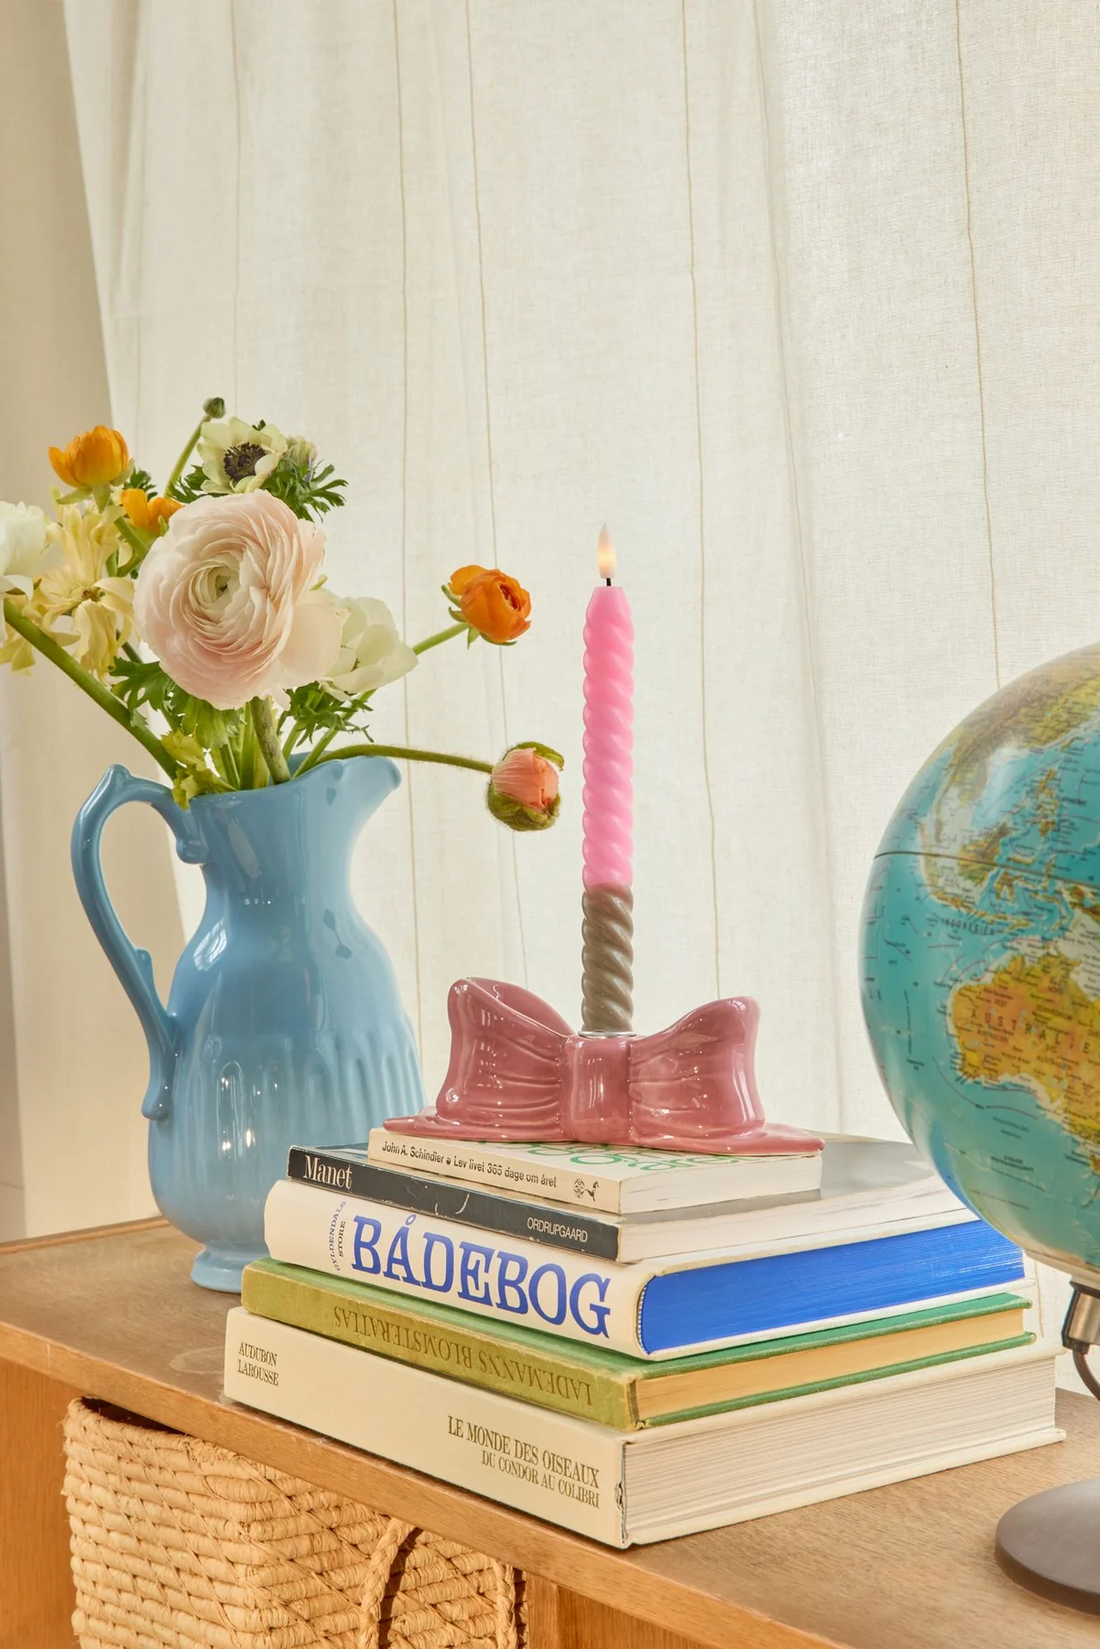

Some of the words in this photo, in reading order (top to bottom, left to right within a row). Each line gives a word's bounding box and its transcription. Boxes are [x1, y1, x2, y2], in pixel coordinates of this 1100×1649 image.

[971, 1008, 1100, 1061] AUSTRALIE
[303, 1155, 353, 1189] Manet
[382, 1141, 400, 1155] John
[400, 1145, 409, 1156] A.
[409, 1146, 445, 1164] Schindler
[453, 1155, 468, 1169] Lev
[468, 1158, 485, 1172] livet
[486, 1163, 503, 1176] 365
[504, 1166, 524, 1181] dage
[525, 1173, 539, 1184] om
[540, 1173, 558, 1188] året
[338, 1221, 346, 1257] STORE
[526, 1217, 588, 1243] ORDRUPGAARD
[351, 1214, 612, 1339] BÅDEBOG
[238, 1341, 278, 1367] AUDUBON
[333, 1305, 472, 1370] BLOMSTERATLAS
[237, 1358, 279, 1386] LAROUSSE
[478, 1351, 593, 1406] LADEMANNS
[448, 1415, 464, 1438] LE
[467, 1422, 511, 1454] MONDE
[514, 1439, 539, 1465] DES
[542, 1450, 600, 1489] OISEAUX
[482, 1450, 496, 1468] DU
[498, 1456, 539, 1484] CONDOR
[540, 1474, 556, 1491] AU
[558, 1479, 600, 1508] COLIBRI
